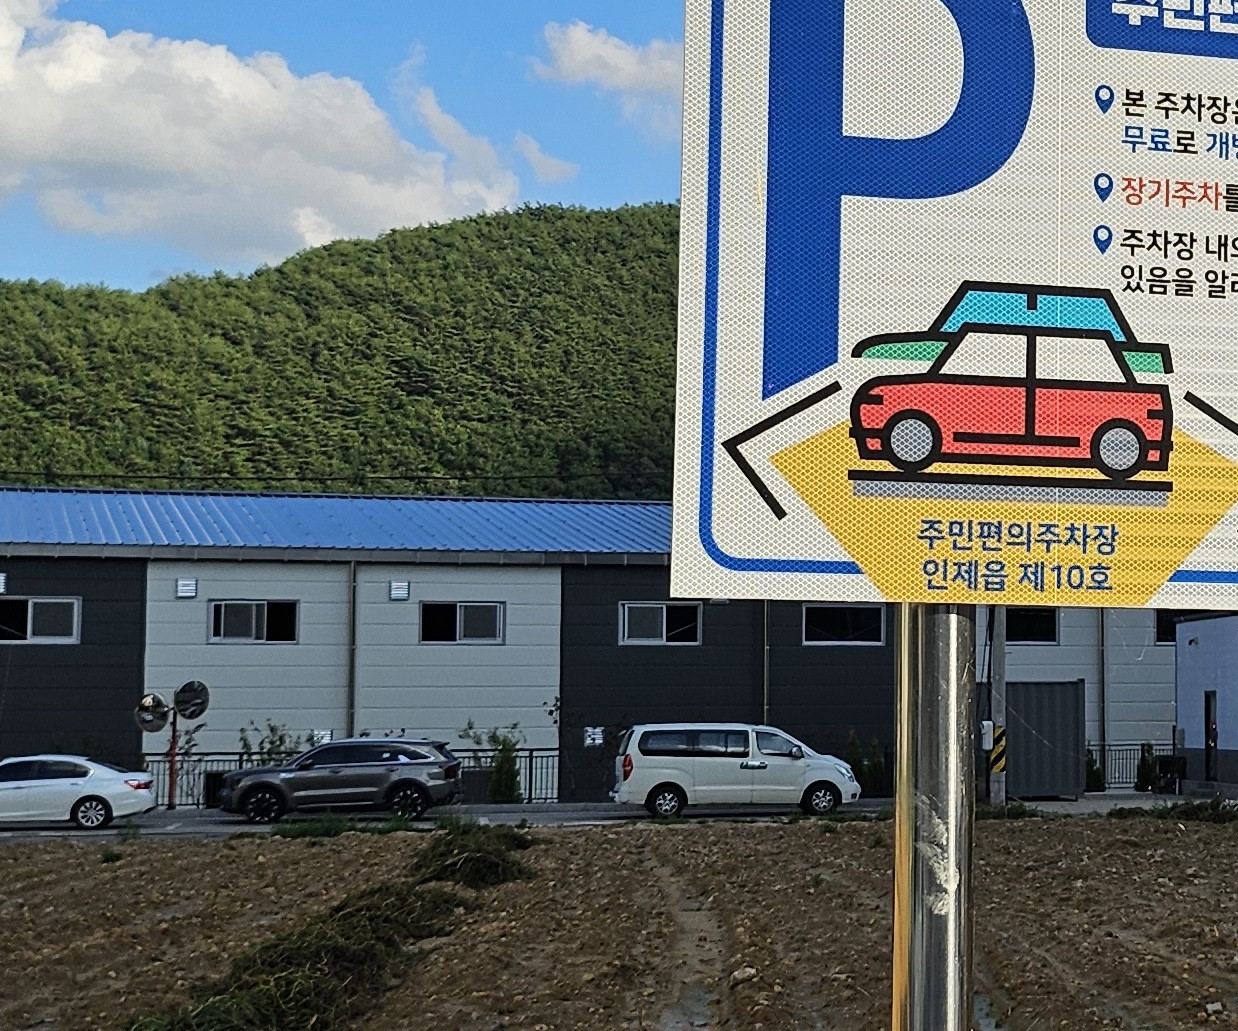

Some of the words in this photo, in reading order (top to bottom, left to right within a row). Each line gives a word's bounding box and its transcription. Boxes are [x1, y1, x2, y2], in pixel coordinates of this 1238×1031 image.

[1121, 88, 1148, 118] 본
[1121, 125, 1199, 155] 무료로
[1119, 228, 1198, 262] 주차장
[1120, 265, 1198, 298] 있음을
[917, 518, 1120, 556] 주민편의주차장
[922, 558, 1009, 592] 인제읍
[1018, 561, 1113, 592] 제10호
